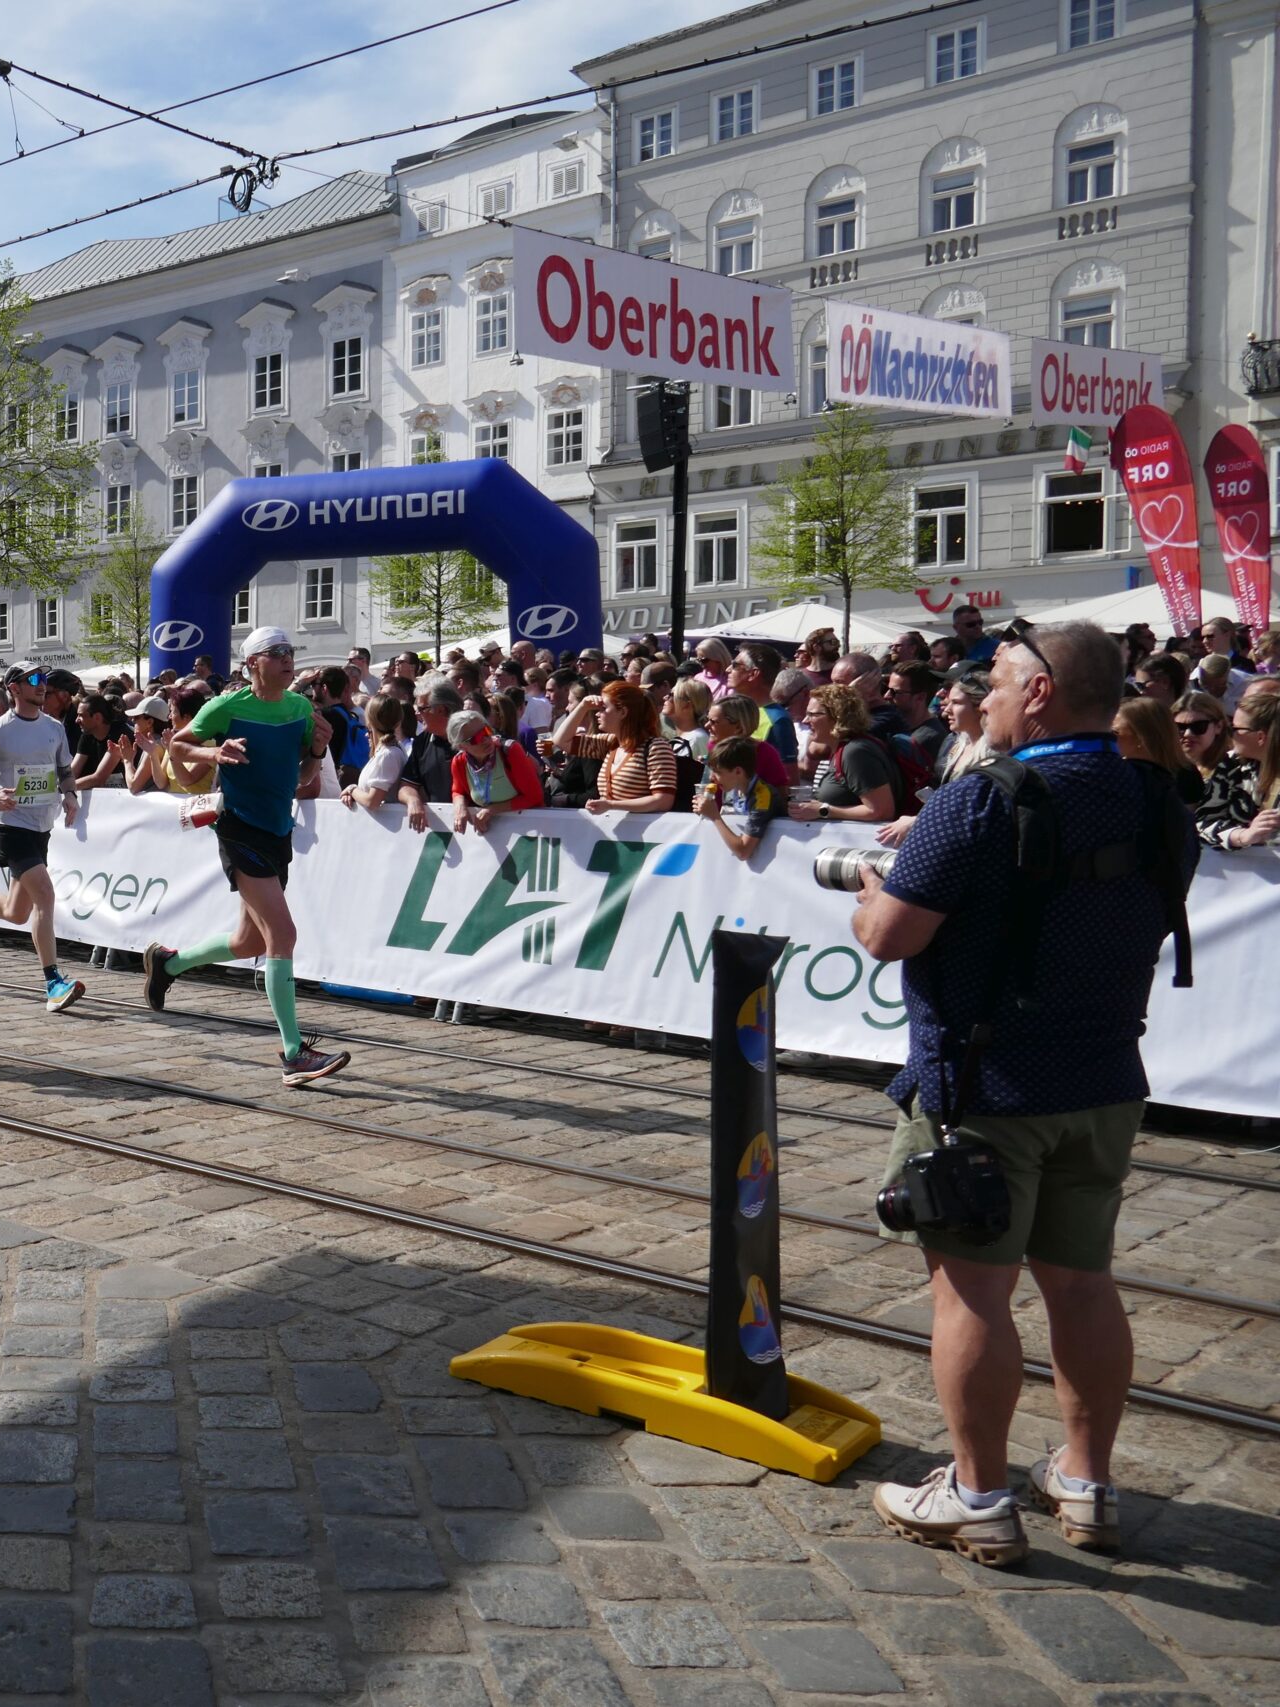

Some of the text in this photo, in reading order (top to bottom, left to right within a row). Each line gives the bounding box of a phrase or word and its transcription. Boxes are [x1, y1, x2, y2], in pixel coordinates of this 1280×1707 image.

[537, 254, 781, 377] Oberbank
[840, 314, 999, 409] OÖNachrichten
[1040, 353, 1153, 416] Oberbank
[639, 463, 765, 497] HTEL
[308, 489, 465, 525] HYUNDAI
[965, 590, 1001, 607] TUI
[44, 653, 75, 662] GUTMANN
[18, 796, 36, 804] LAT
[24, 780, 48, 791] 5230
[386, 831, 910, 1031] LAT Nrog
